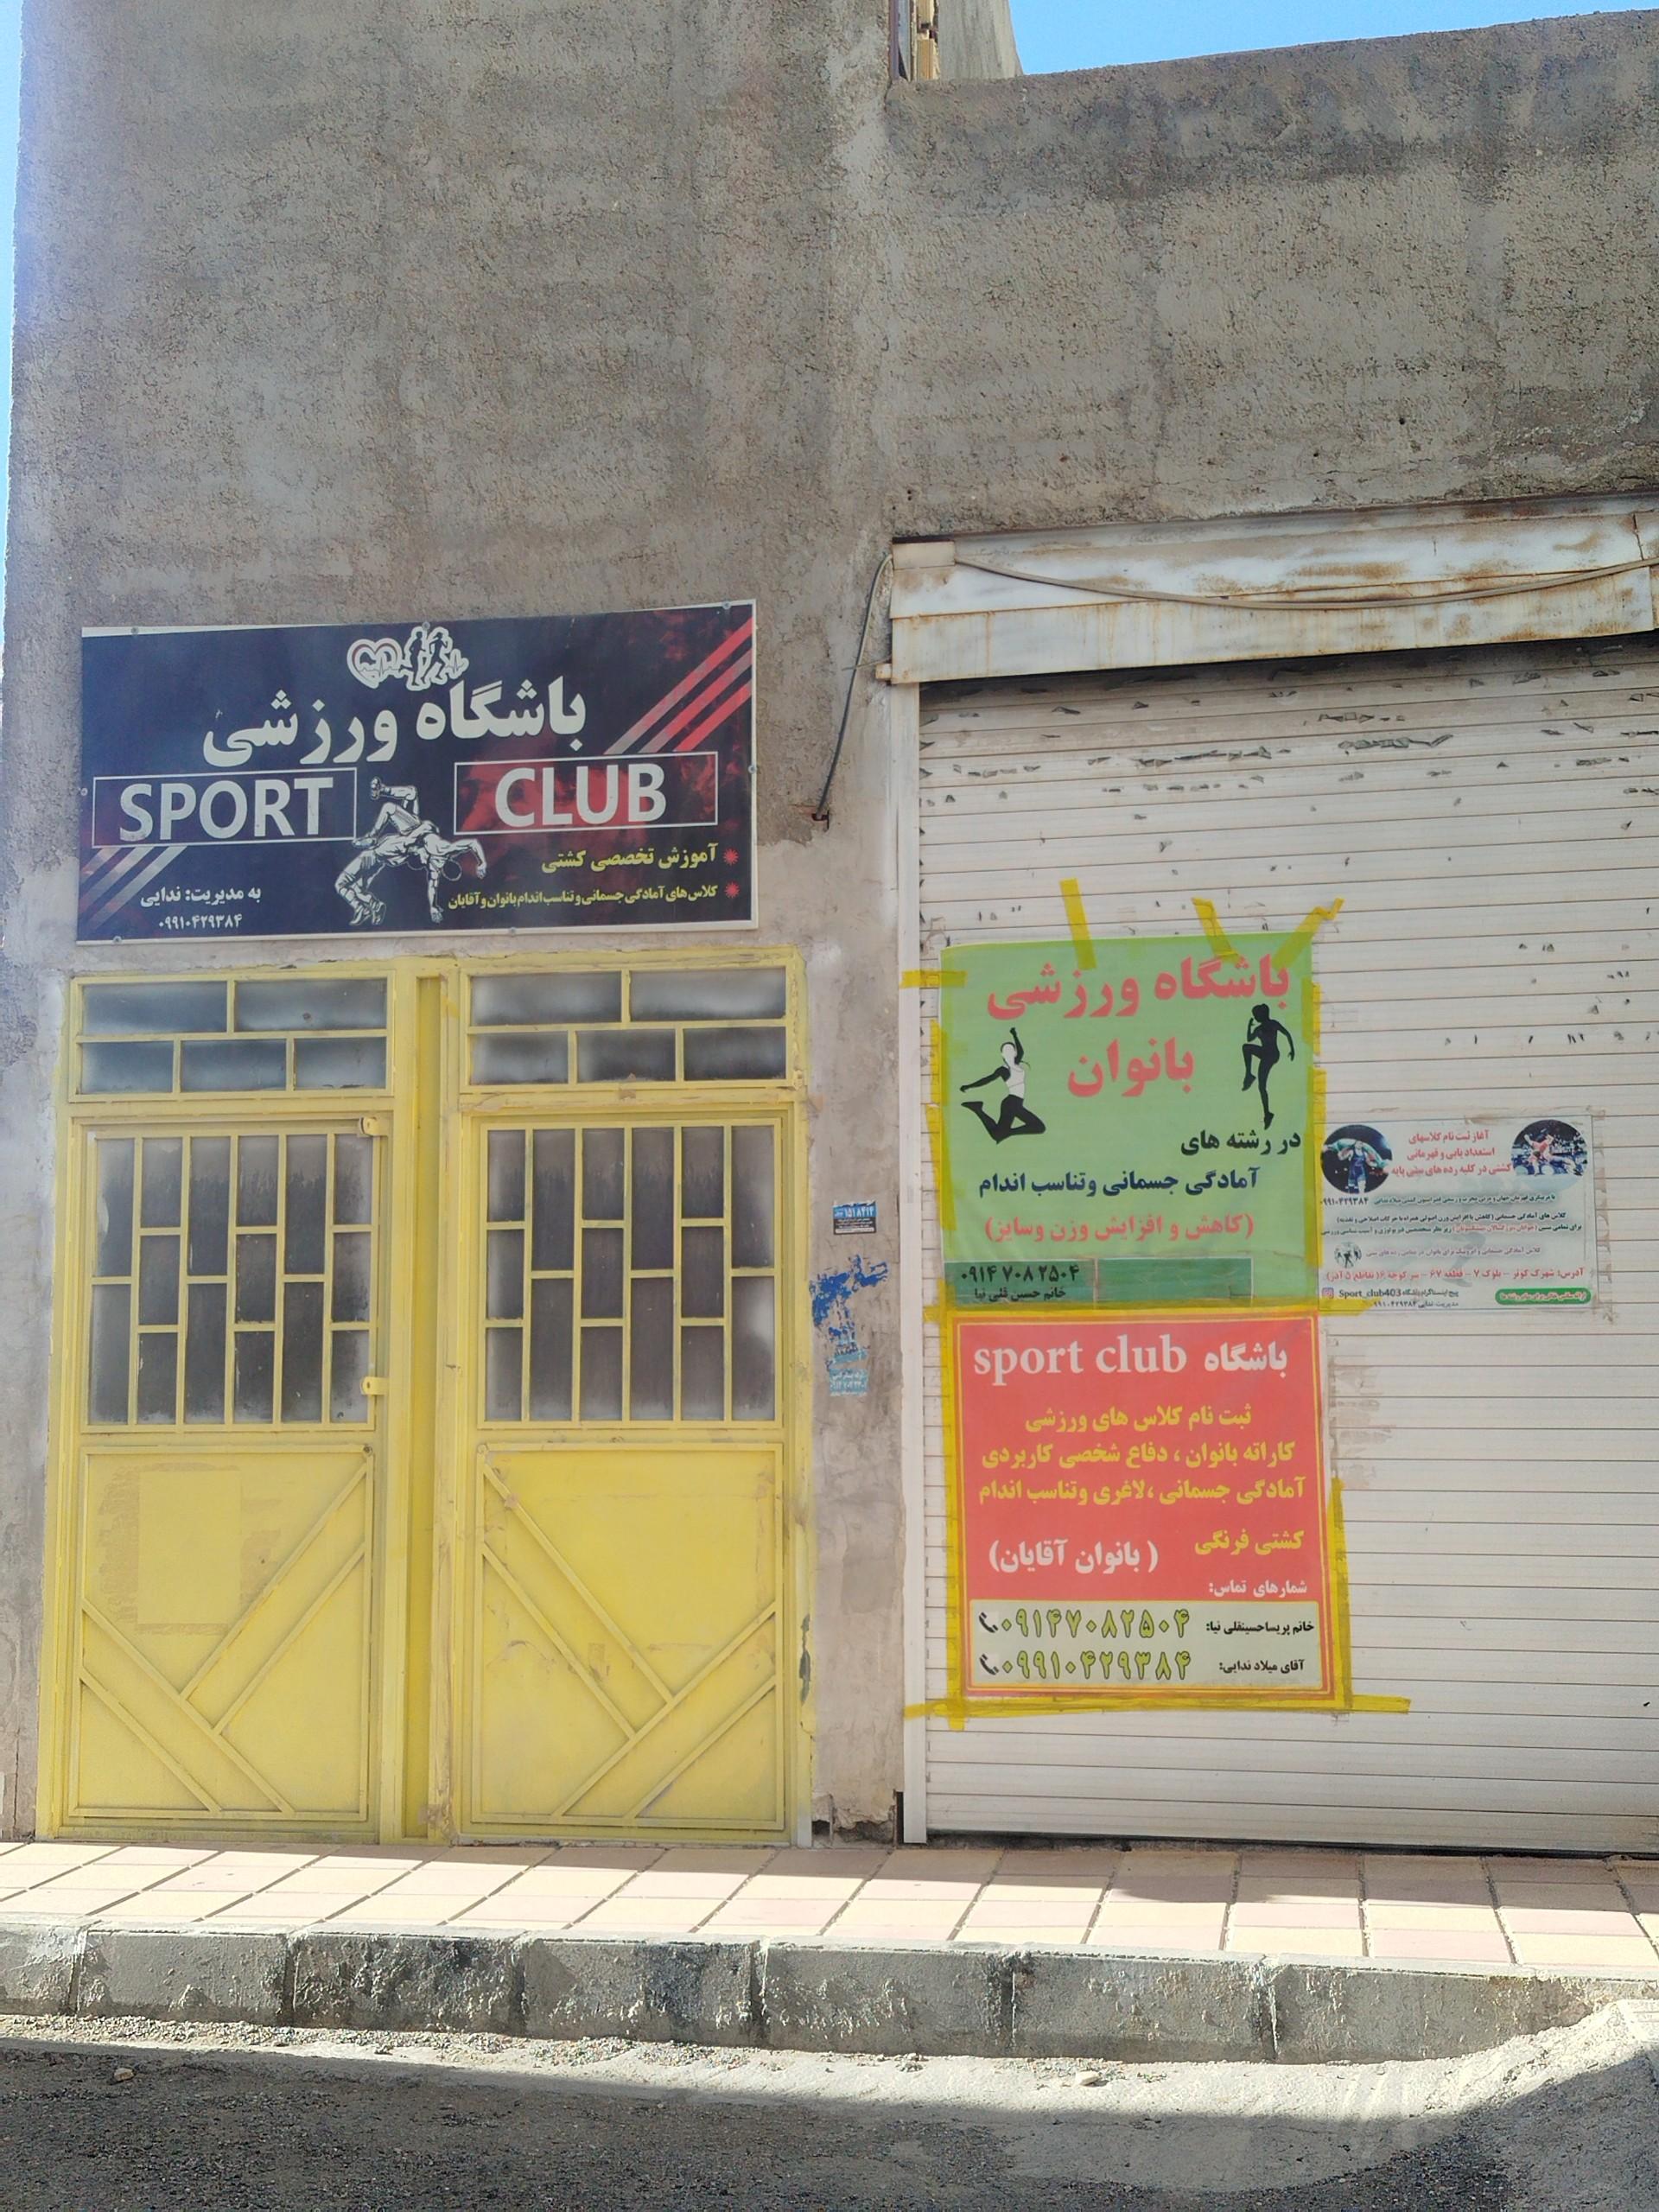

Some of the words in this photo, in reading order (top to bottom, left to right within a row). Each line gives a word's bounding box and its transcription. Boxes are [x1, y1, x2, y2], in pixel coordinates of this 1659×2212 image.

[416, 676, 586, 752] باشگاه
[203, 690, 397, 767] ورزشی
[119, 777, 334, 842] SPORT
[494, 764, 667, 826] CLUB
[541, 850, 587, 874] کشتی
[590, 848, 654, 873] تخصصی
[658, 842, 718, 869] آموزش
[140, 886, 181, 907] ندایی
[185, 887, 245, 906] مدیریت:
[248, 887, 261, 903] به
[448, 891, 482, 909] آقایان
[488, 893, 518, 907] بانوان
[518, 891, 544, 906] اندام
[582, 890, 624, 905] جسمانی
[625, 886, 665, 904] آمادگی
[667, 887, 688, 901] های
[689, 885, 718, 899] کلاس
[159, 913, 243, 930] ۰۹۹۱۰۴۲۹۳۸۴
[987, 962, 1140, 1020] ورزشی
[1154, 954, 1291, 1010] باشگاه
[1067, 1037, 1195, 1096] بانوان
[1180, 1129, 1220, 1156] های
[1226, 1129, 1272, 1155] رشته
[1277, 1132, 1301, 1155] در
[979, 1172, 1026, 1198] اندام
[1103, 1170, 1179, 1197] جسمانی
[1185, 1166, 1261, 1195] آمادگی
[1050, 1220, 1089, 1242] وزن
[1094, 1214, 1163, 1242] افزایش
[1169, 1221, 1179, 1240] و
[974, 1336, 1083, 1386] sport
[1096, 1334, 1188, 1375] club
[1204, 1340, 1288, 1376] باشگاه
[1025, 1408, 1087, 1433] ورزشی
[1092, 1407, 1128, 1432] های
[1133, 1405, 1183, 1431] کلاس
[1188, 1406, 1213, 1431] نام
[1218, 1403, 1251, 1428] ثبت
[982, 1444, 1053, 1469] کاربردی
[1058, 1442, 1120, 1468] شخصی
[1125, 1442, 1168, 1468] دفاع
[1185, 1442, 1237, 1468] بانوان
[1243, 1440, 1295, 1467] کاراته
[979, 1479, 1022, 1504] اندام
[1159, 1478, 1230, 1504] جسمانی
[1236, 1476, 1306, 1504] آمادگی
[1194, 1529, 1249, 1555] فرنگی
[1255, 1530, 1304, 1555] کشتی
[1001, 1607, 1191, 1640] ۰۹۱۴۷۰۸۲۵۰۴
[1293, 1620, 1314, 1635] خانم
[1002, 1650, 1192, 1681] ۰۹۹۱۰۴۲۹۳۸۴
[1254, 1660, 1278, 1674] میلاد
[1281, 1659, 1305, 1674] آقای
